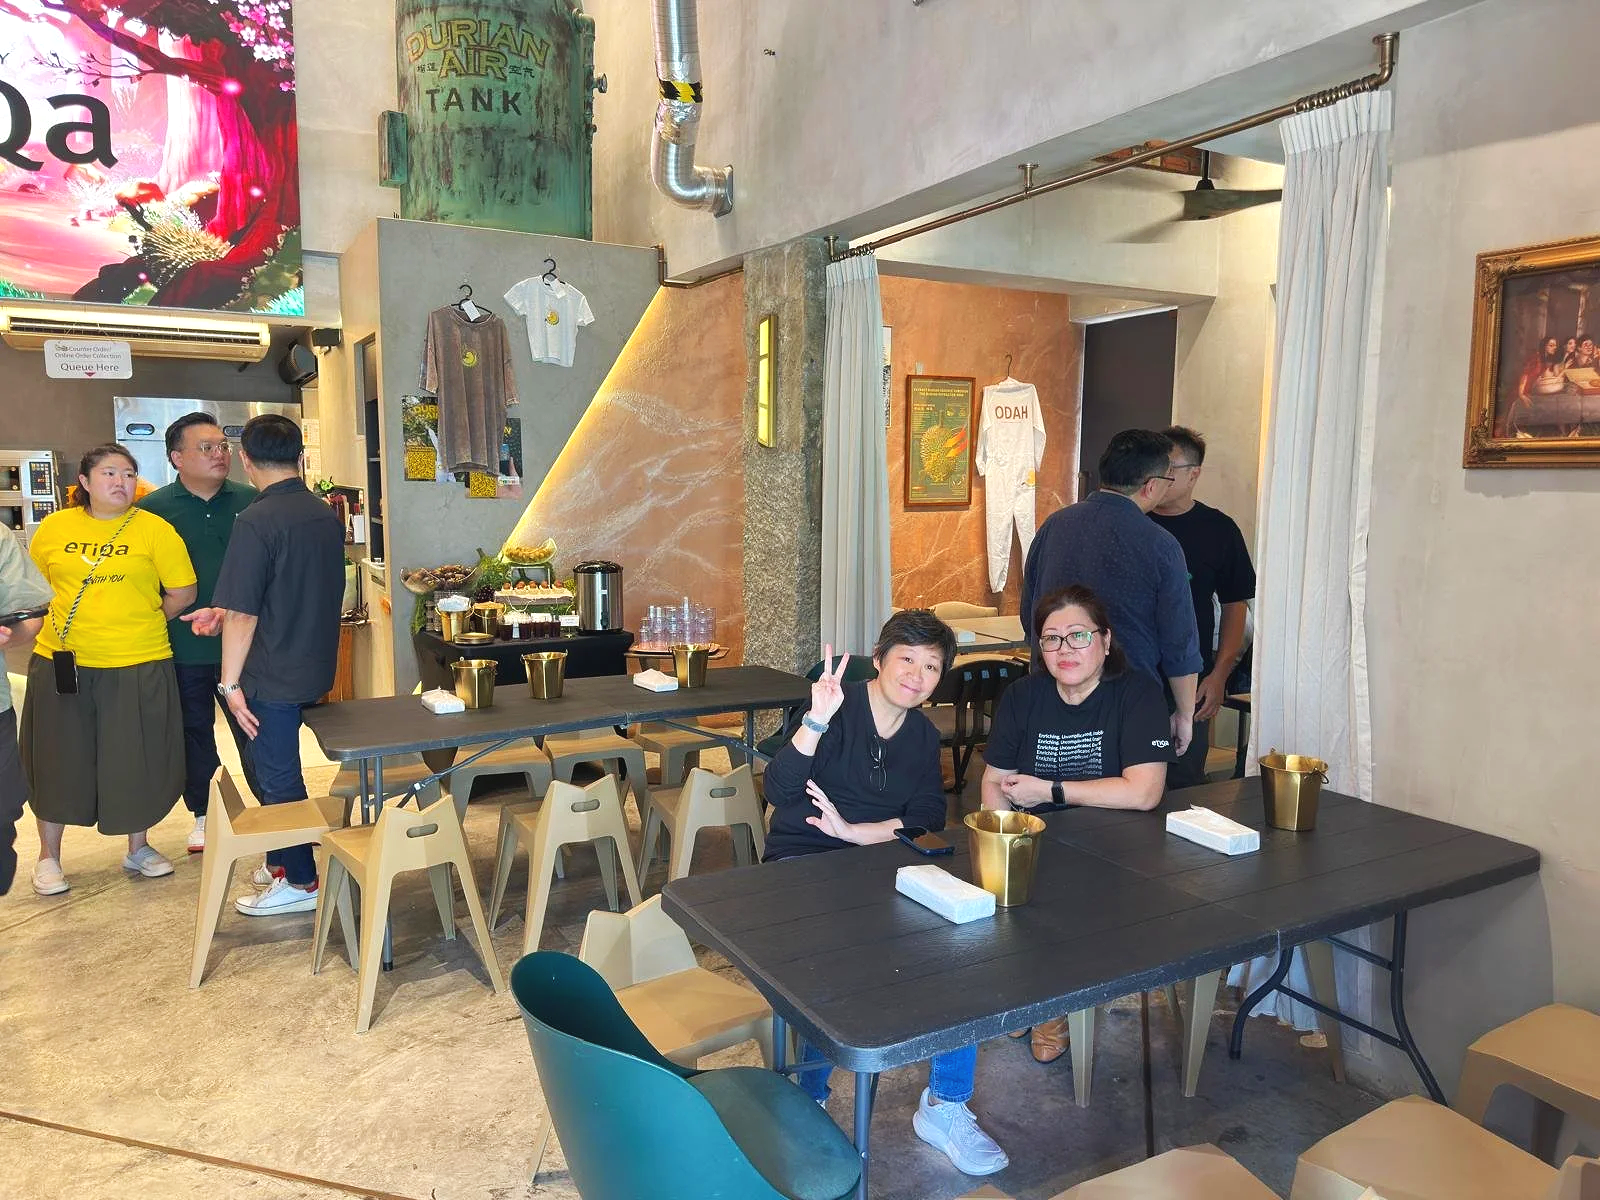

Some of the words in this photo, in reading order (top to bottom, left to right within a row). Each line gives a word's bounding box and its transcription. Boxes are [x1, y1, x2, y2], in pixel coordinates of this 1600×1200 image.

[406, 18, 552, 68] DURIAN
[438, 46, 508, 81] AIR
[425, 86, 522, 116] TANK
[60, 363, 94, 371] Queue
[96, 363, 119, 371] Here
[994, 405, 1028, 420] ODAH
[108, 574, 126, 583] YOU
